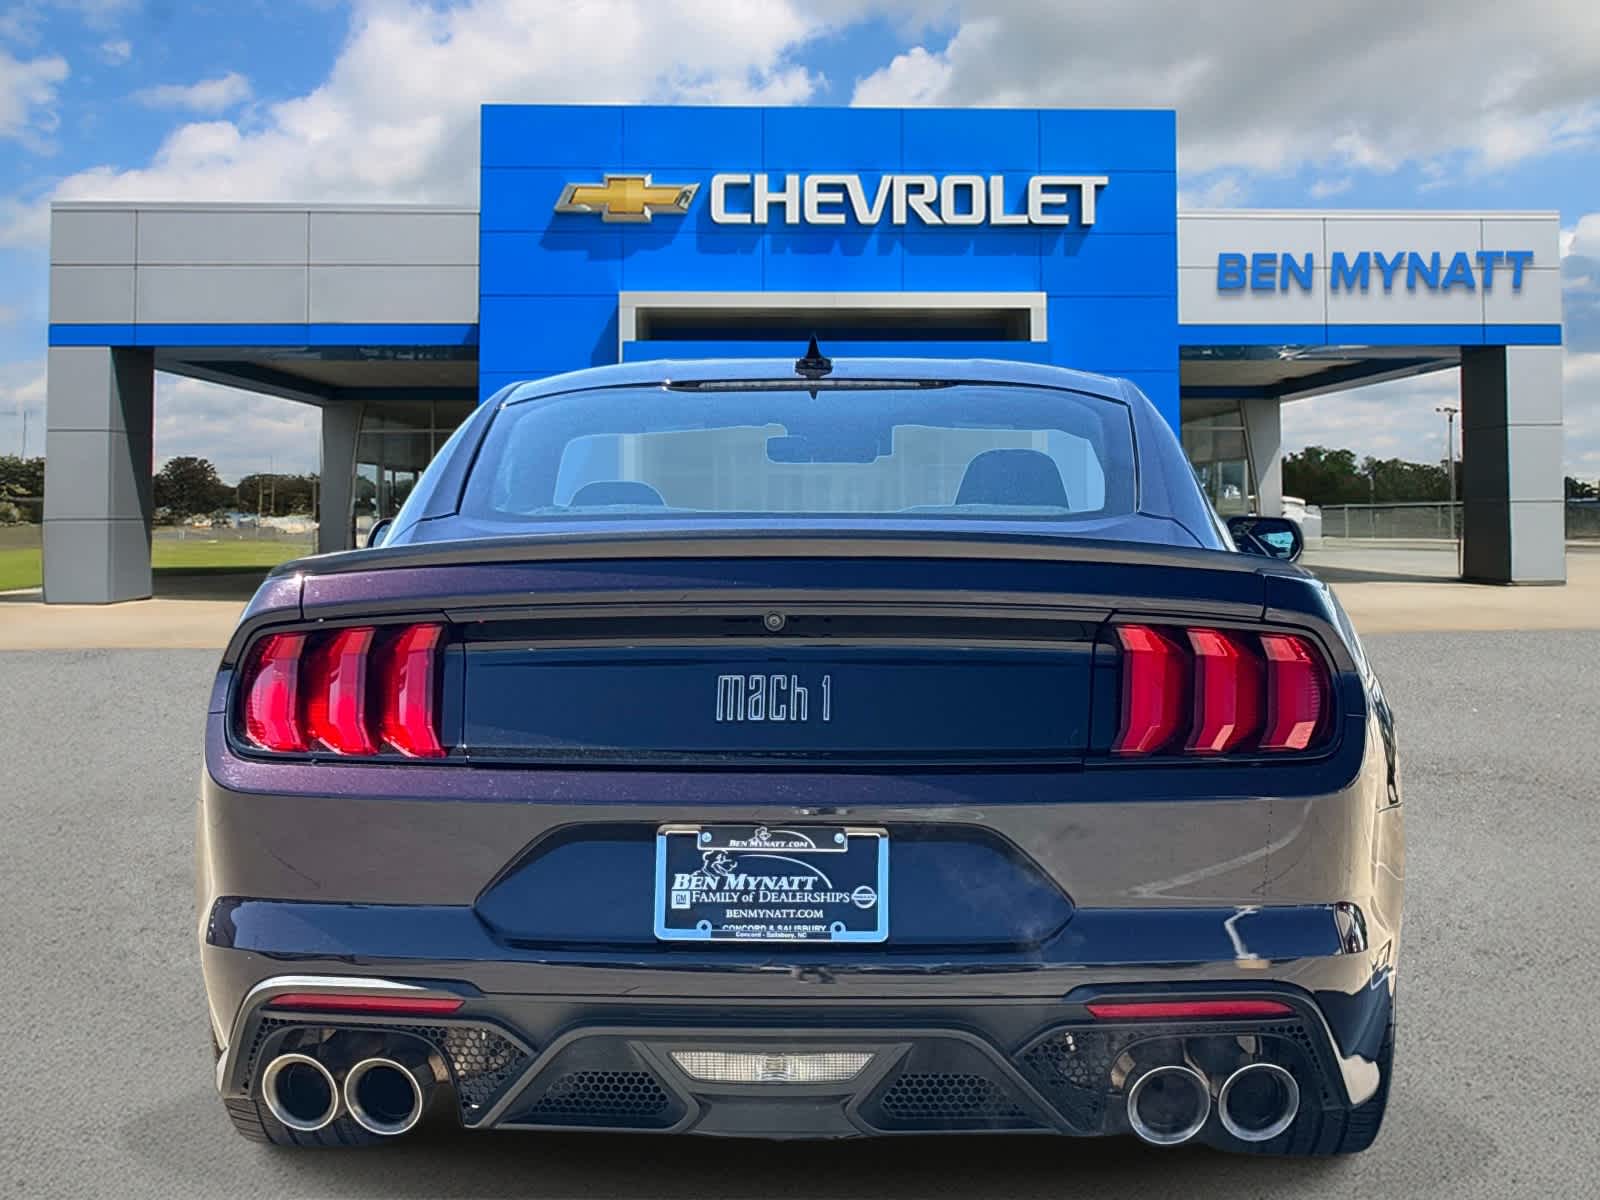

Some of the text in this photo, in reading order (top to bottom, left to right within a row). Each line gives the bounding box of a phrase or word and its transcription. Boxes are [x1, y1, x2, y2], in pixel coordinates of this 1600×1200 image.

[711, 174, 1108, 225] CHEVROLET
[1217, 251, 1533, 290] BEN MYNATT
[822, 675, 831, 721] 1
[672, 873, 817, 890] BEN MYNATT
[691, 892, 740, 903] FAMILY
[742, 892, 755, 903] of
[759, 892, 850, 903] DEALERSHIPS
[726, 909, 824, 918] BENMYNATT.COM
